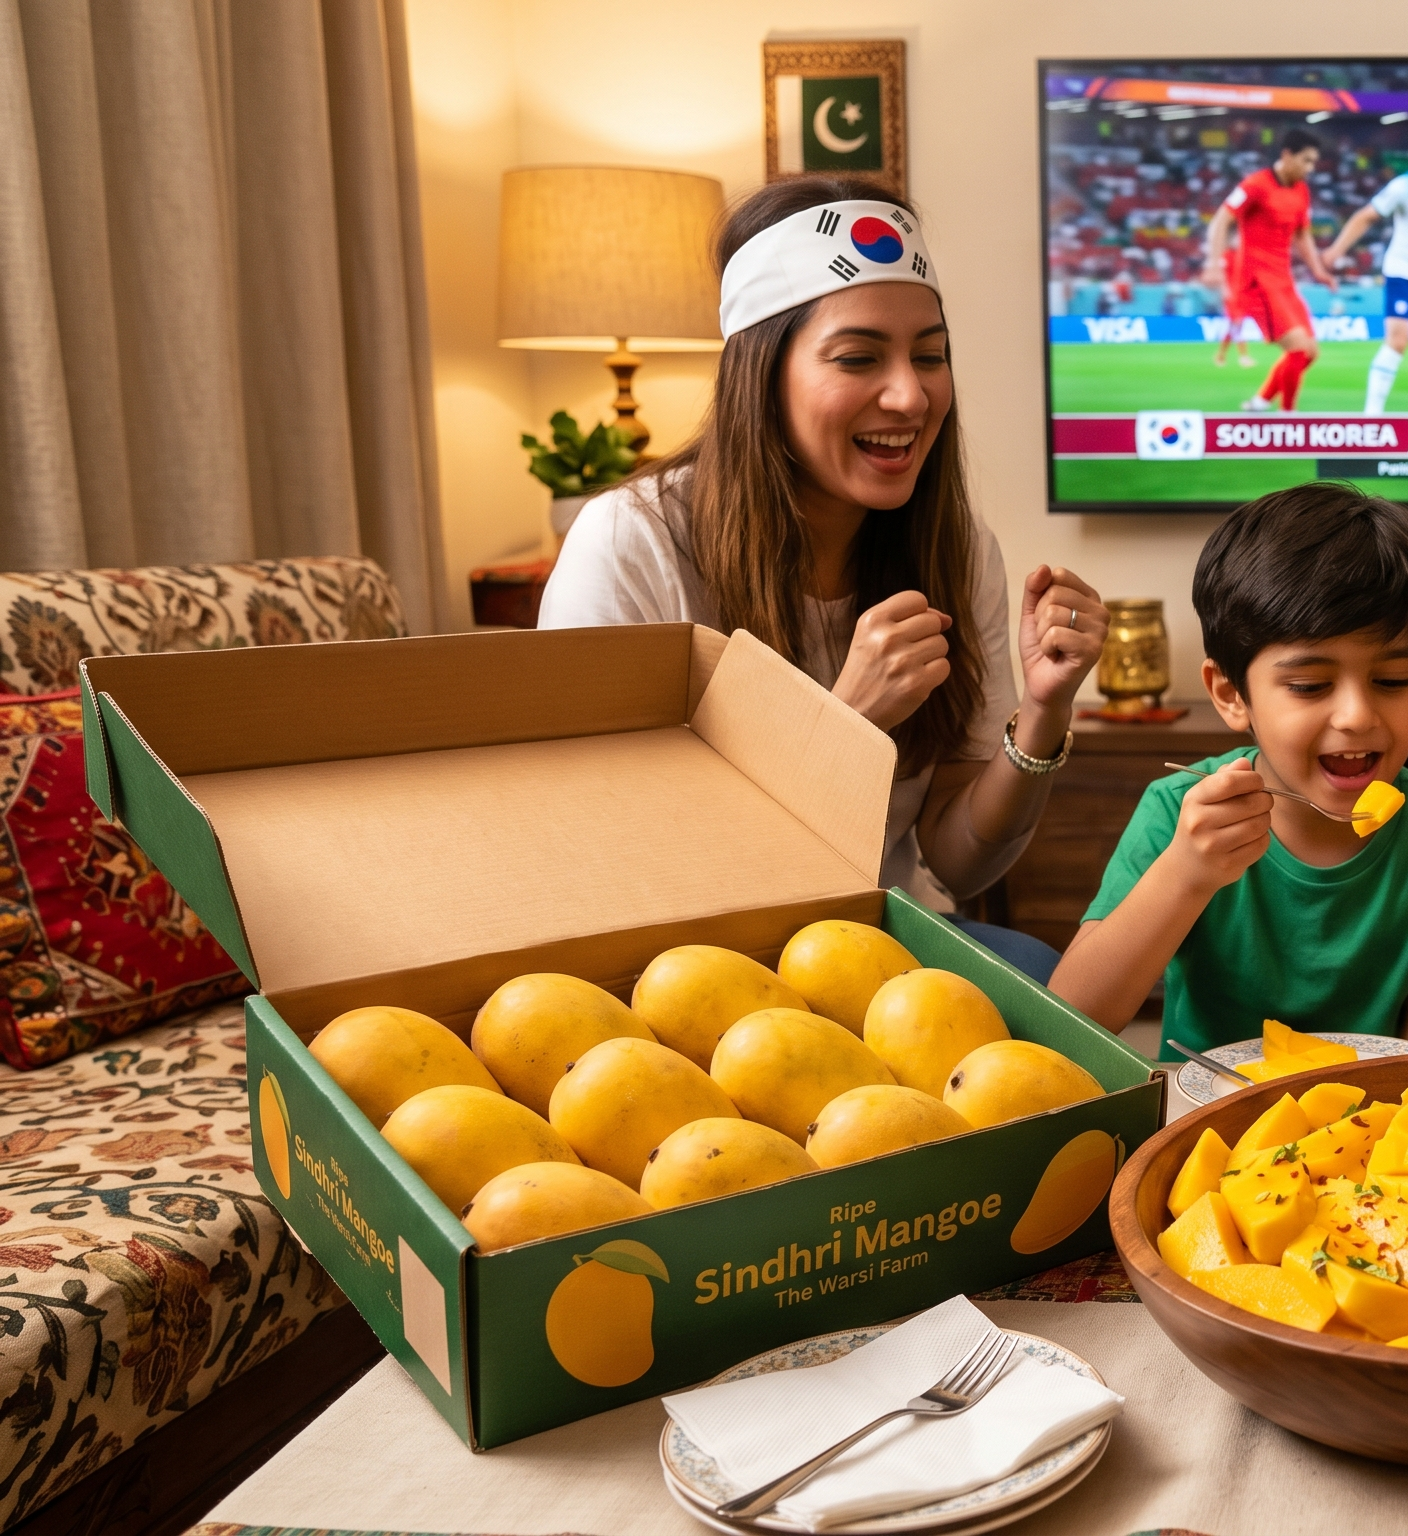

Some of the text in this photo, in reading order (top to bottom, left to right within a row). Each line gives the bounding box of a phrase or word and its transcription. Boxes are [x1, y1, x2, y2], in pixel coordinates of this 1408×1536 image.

[1081, 316, 1149, 342] VISA
[1216, 423, 1305, 447] SOUTH
[1309, 423, 1398, 447] KOREA
[295, 1134, 395, 1274] Sindhri Mangoe
[830, 1199, 877, 1225] Ripe
[694, 1193, 1002, 1305] Sindhri Mangoe
[774, 1251, 929, 1309] The Warsi Farm
